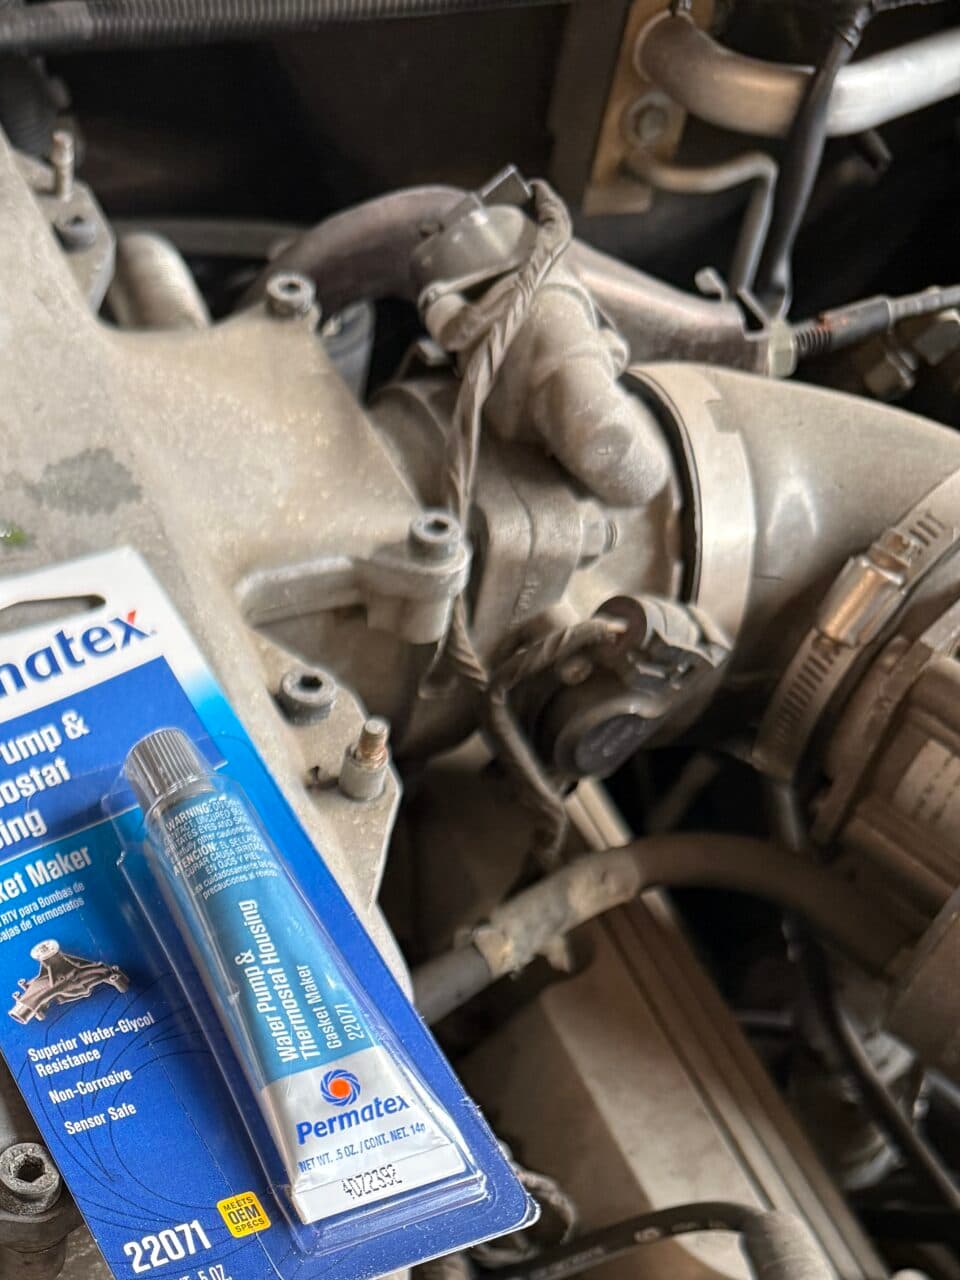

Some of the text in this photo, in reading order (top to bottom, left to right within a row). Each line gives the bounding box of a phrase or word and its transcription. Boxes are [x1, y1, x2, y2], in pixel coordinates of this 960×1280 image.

[61, 709, 90, 740] &
[25, 848, 91, 888] Maker
[0, 909, 19, 927] RTV
[19, 902, 39, 918] para
[37, 885, 73, 908] Bombas
[73, 881, 85, 893] de
[20, 919, 33, 931] de
[31, 897, 85, 926] Termostatos
[237, 899, 321, 1061] Thermostat Housing
[234, 950, 299, 1063] Water Pump &
[296, 964, 342, 1050] Gasket Maker
[334, 1003, 365, 1041] 22071
[28, 1011, 155, 1062] Superior Water-Glycol
[35, 1048, 101, 1077] Resistance
[48, 1069, 133, 1104] Non-Corrosive
[64, 1103, 136, 1135] Sensor Safe
[296, 1095, 410, 1145] Permatex
[298, 1157, 315, 1173] NET
[316, 1152, 333, 1167] WT.
[344, 1143, 359, 1157] OZ.
[364, 1132, 390, 1151] CONT.
[390, 1126, 410, 1141] NET.
[223, 1197, 253, 1211] MEETS
[228, 1204, 261, 1225] OEM
[234, 1217, 264, 1232] SPECS
[123, 1219, 212, 1273] 22071
